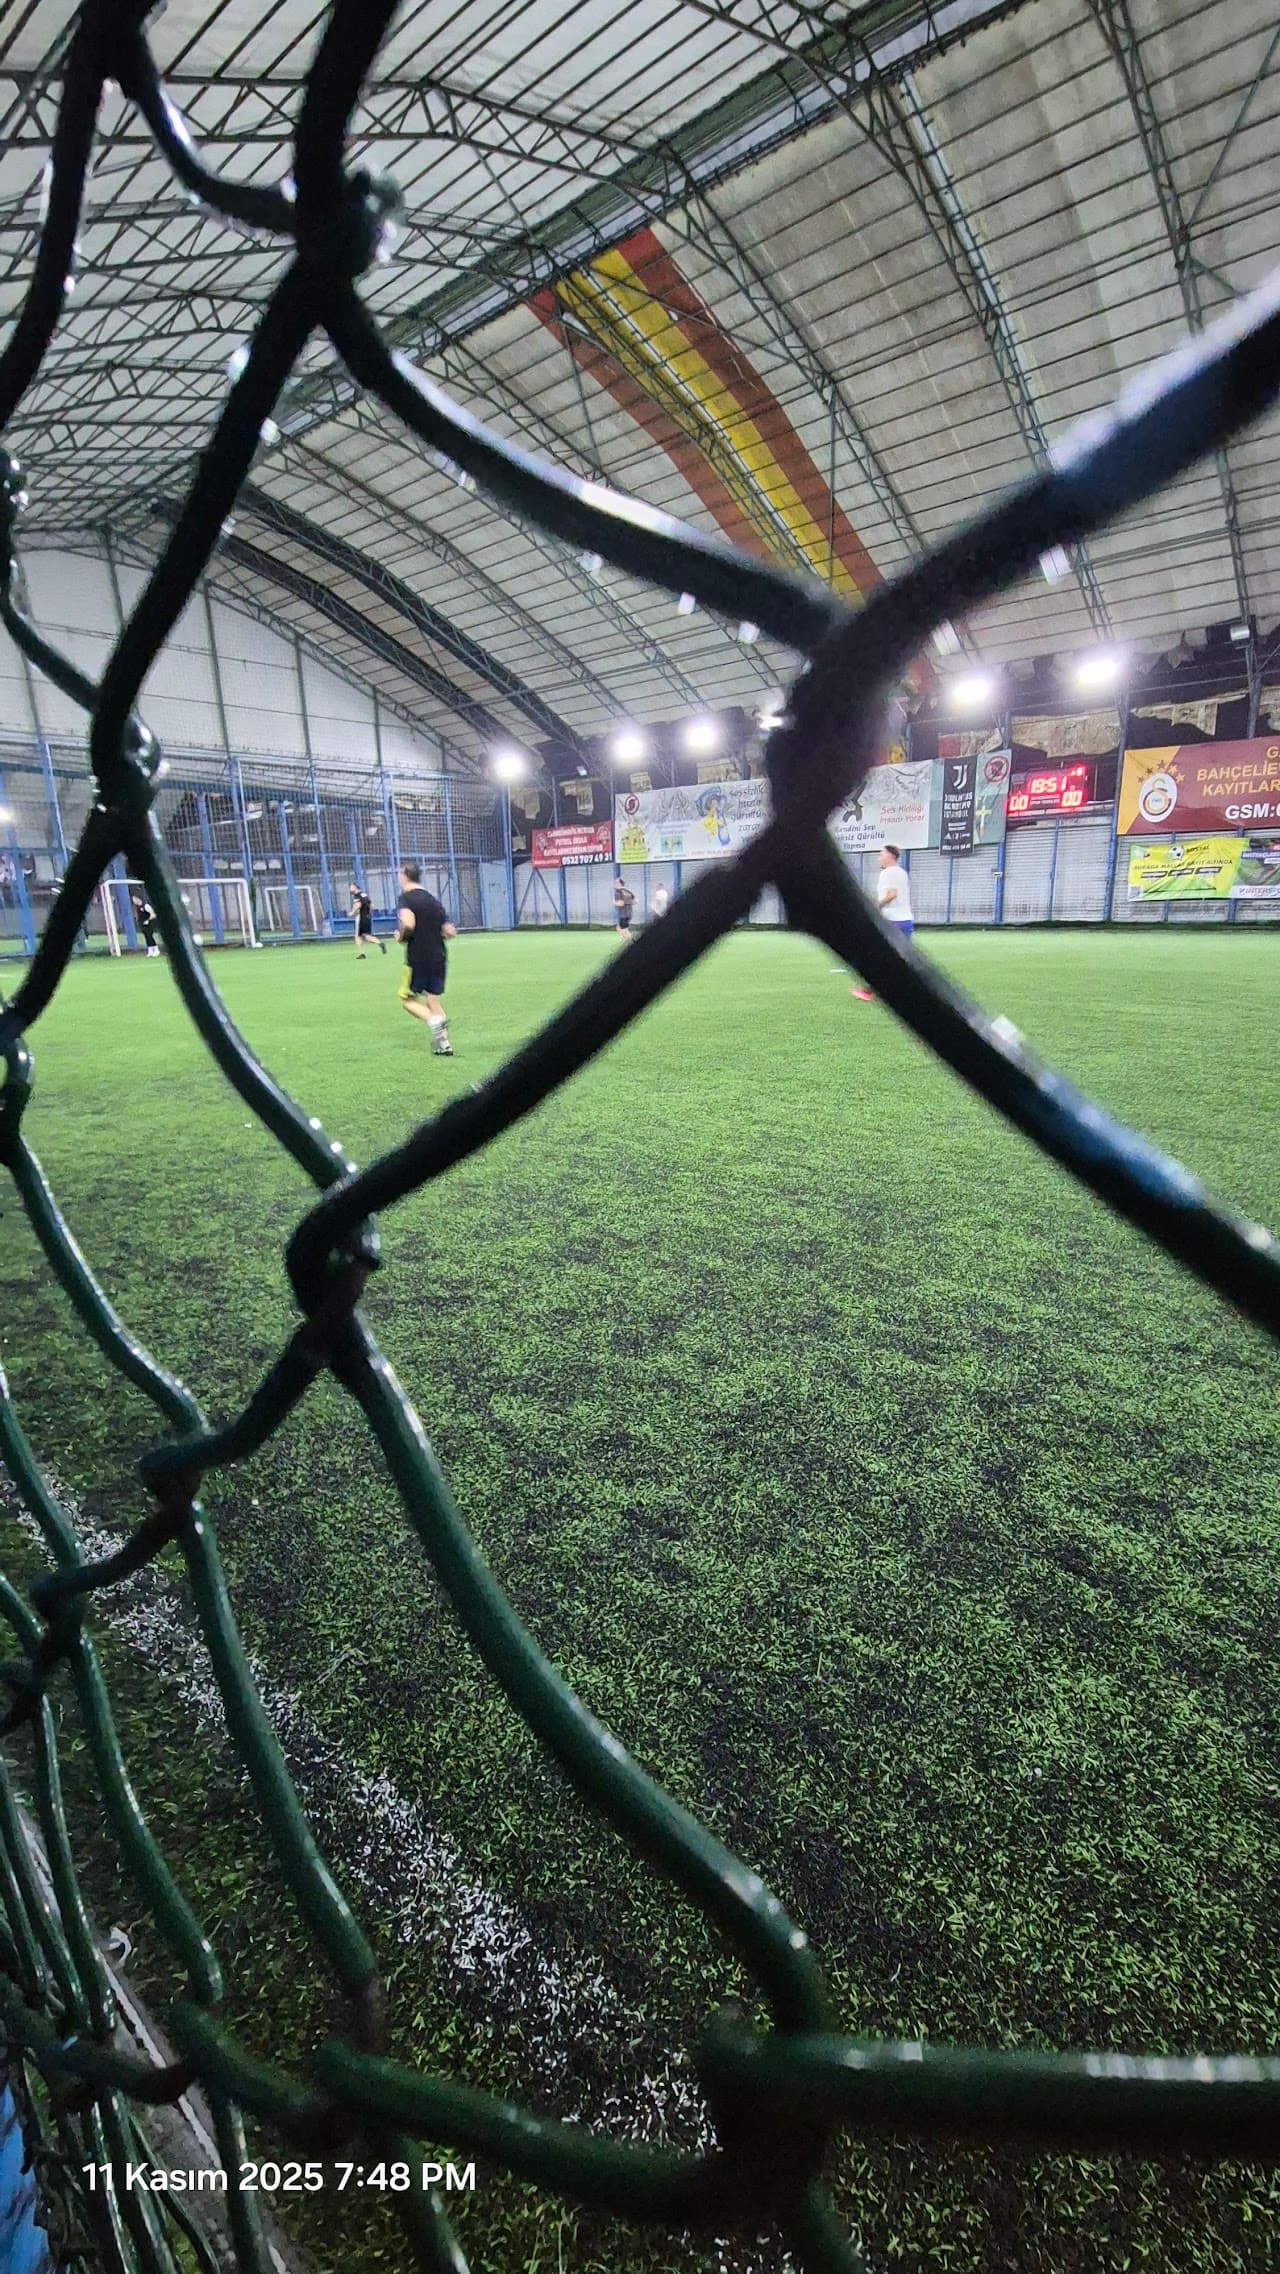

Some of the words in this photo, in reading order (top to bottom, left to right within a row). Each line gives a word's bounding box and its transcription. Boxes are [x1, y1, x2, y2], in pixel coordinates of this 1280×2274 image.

[1196, 760, 1280, 784] BAHÇELİE
[1203, 779, 1280, 797] KAYITLAR
[1009, 795, 1029, 811] 00
[1061, 790, 1083, 807] 00
